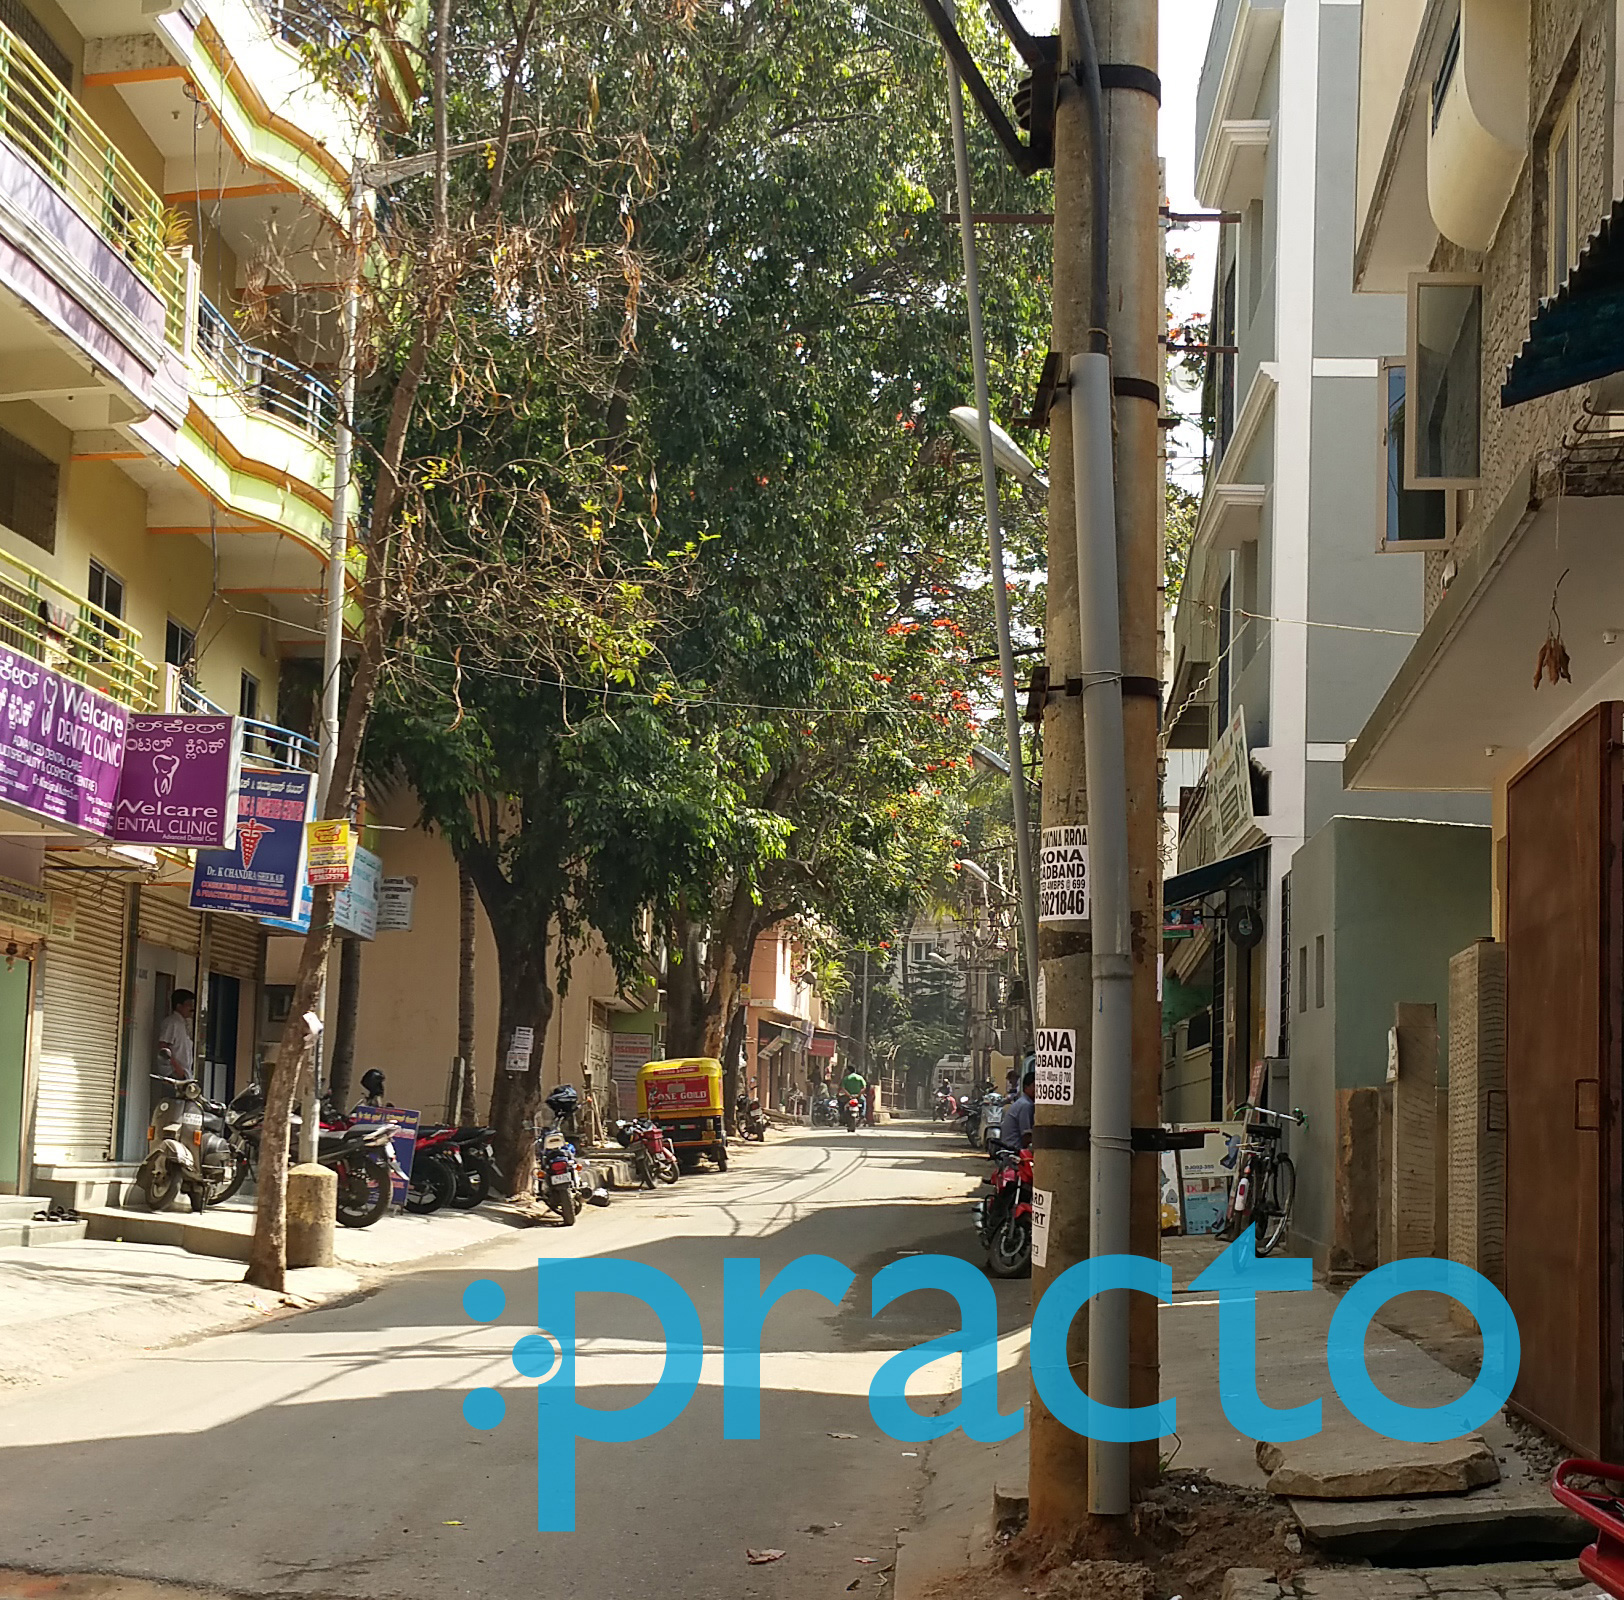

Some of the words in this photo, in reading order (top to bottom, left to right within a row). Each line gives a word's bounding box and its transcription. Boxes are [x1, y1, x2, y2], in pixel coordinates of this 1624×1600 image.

[62, 682, 125, 738] Welcare
[57, 717, 92, 756] DENTAL
[93, 734, 122, 768] CLINIC
[169, 817, 218, 835] CLINIC
[1072, 879, 1086, 890] 699
